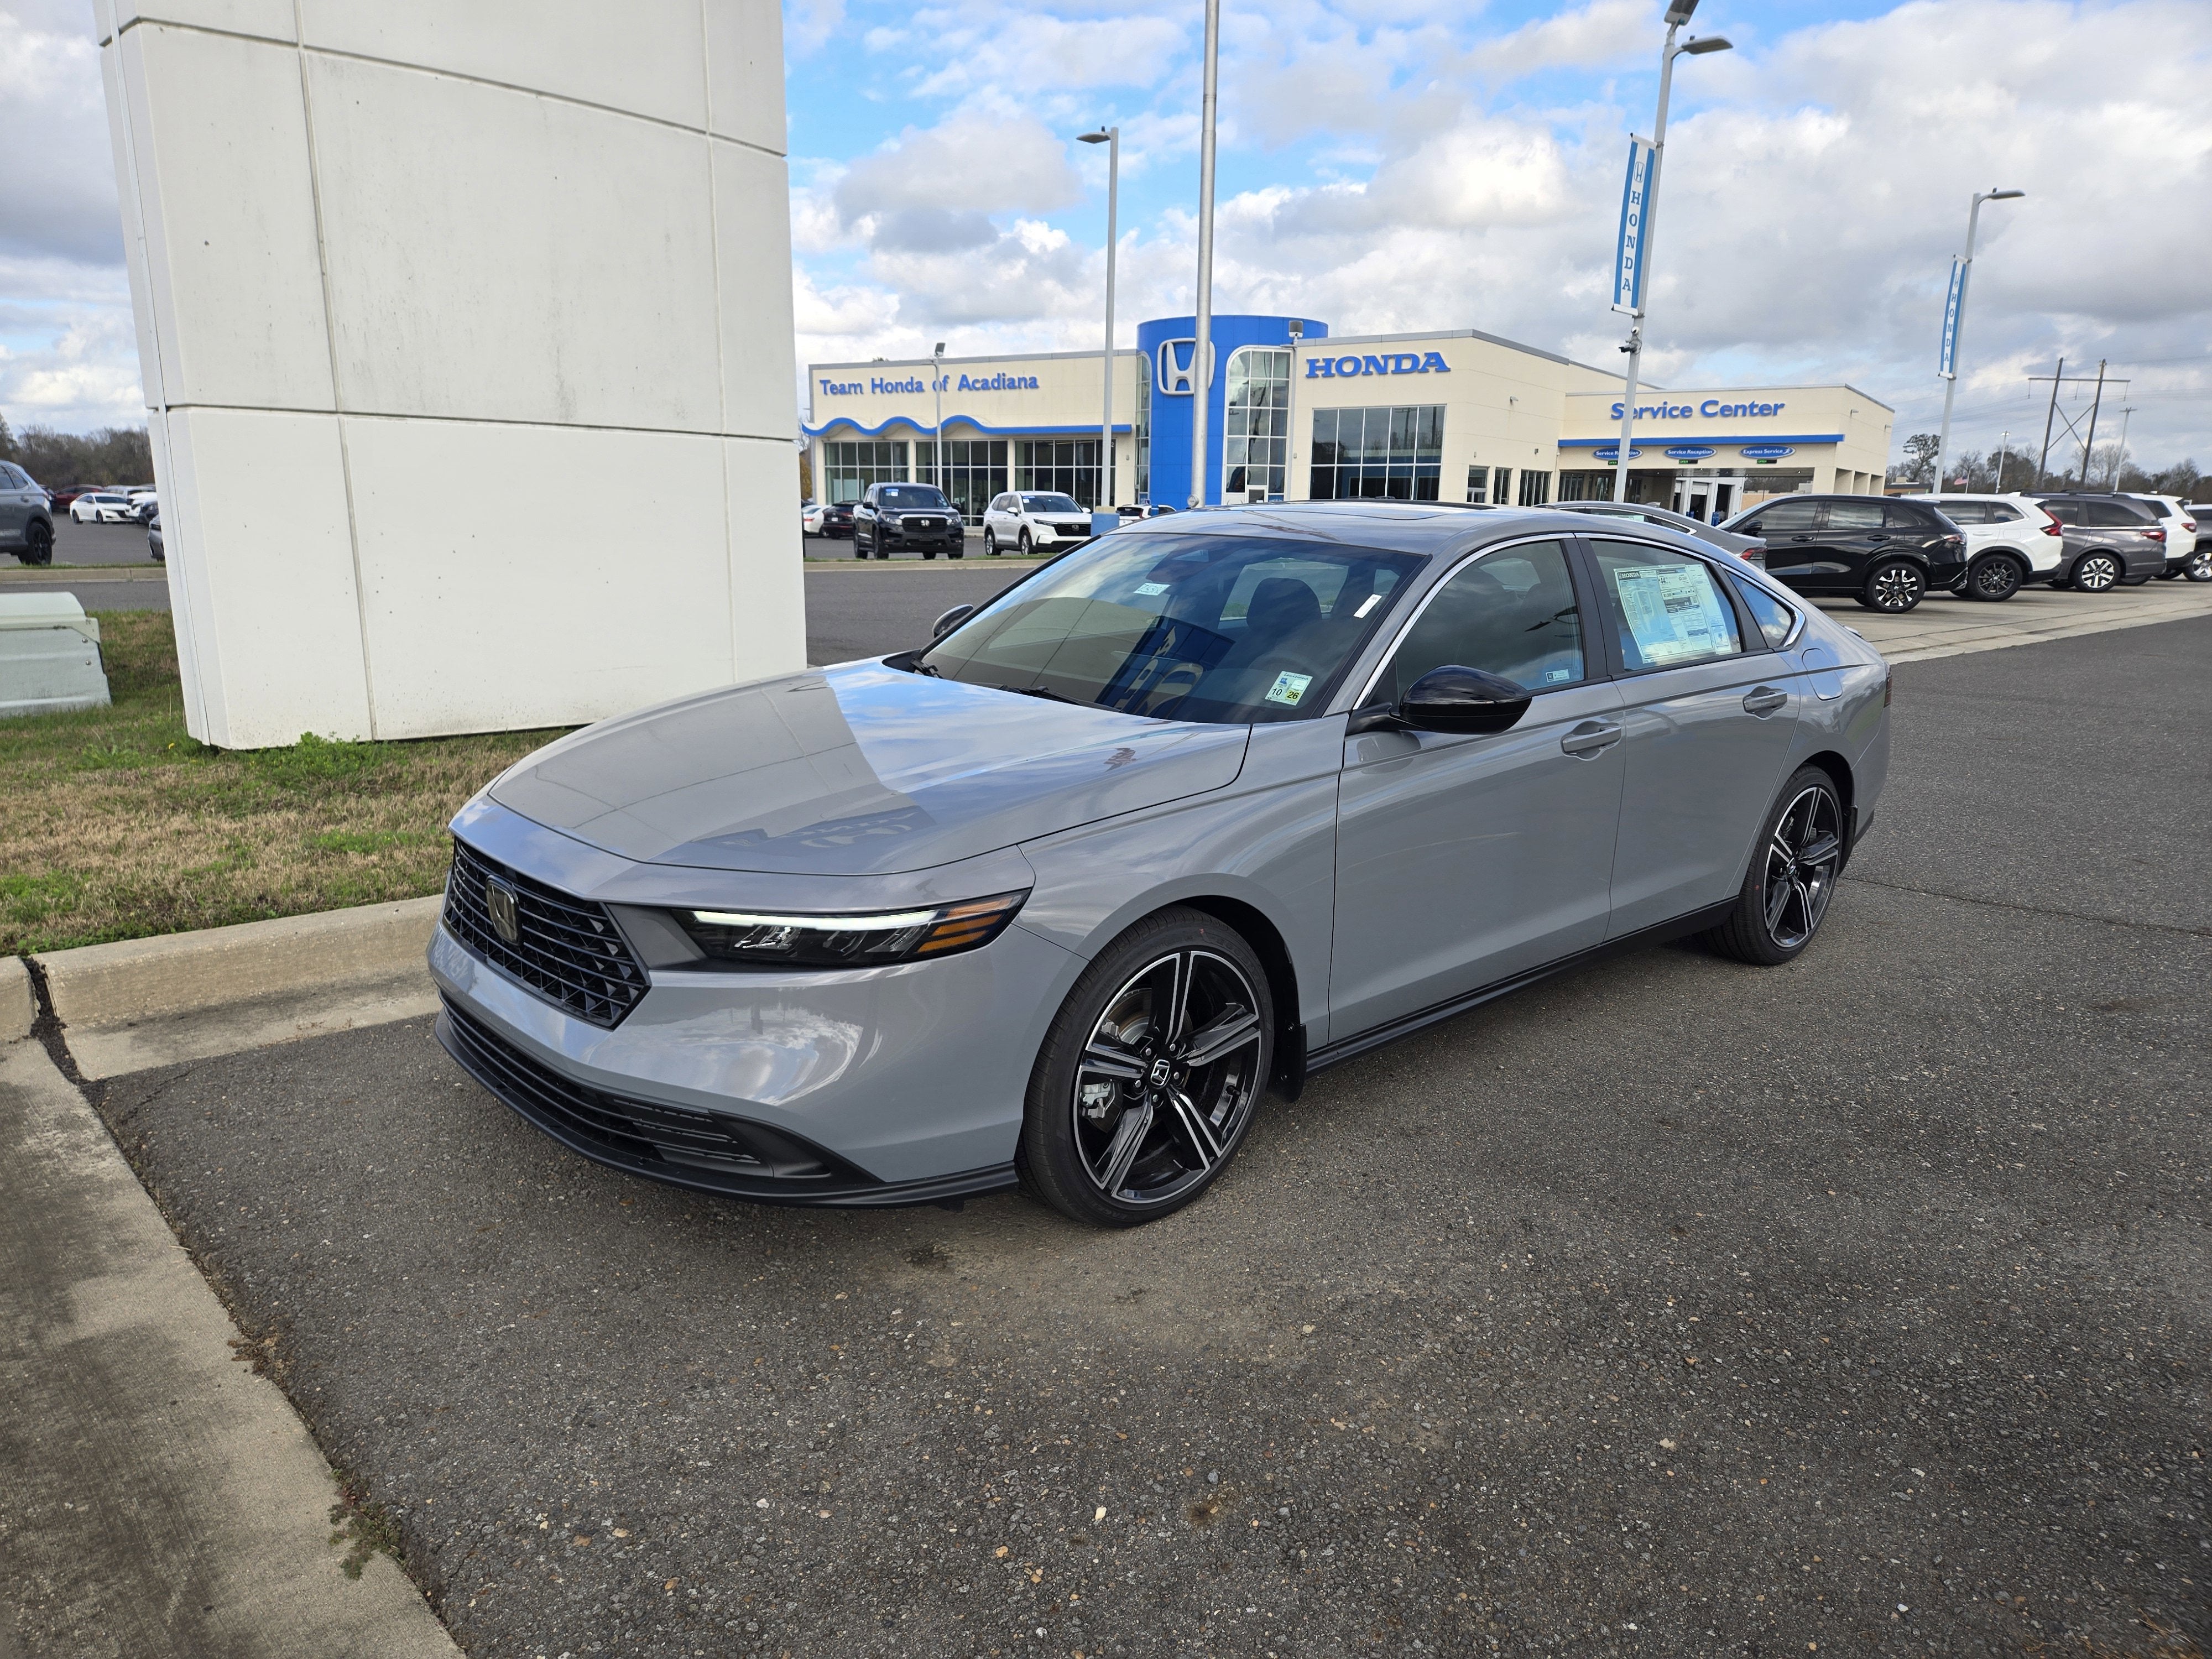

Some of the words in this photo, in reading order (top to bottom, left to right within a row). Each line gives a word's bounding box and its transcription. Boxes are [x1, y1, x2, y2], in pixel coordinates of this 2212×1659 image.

[1622, 190, 1641, 291] HONDA
[1944, 293, 1957, 362] HONDA
[1306, 352, 1451, 378] HONDA
[820, 379, 863, 395] Team
[871, 377, 924, 393] Honda
[932, 374, 950, 392] of
[958, 372, 1039, 390] Acadiana
[1700, 399, 1785, 418] Center
[1272, 687, 1283, 696] 10
[1286, 691, 1300, 700] 26
